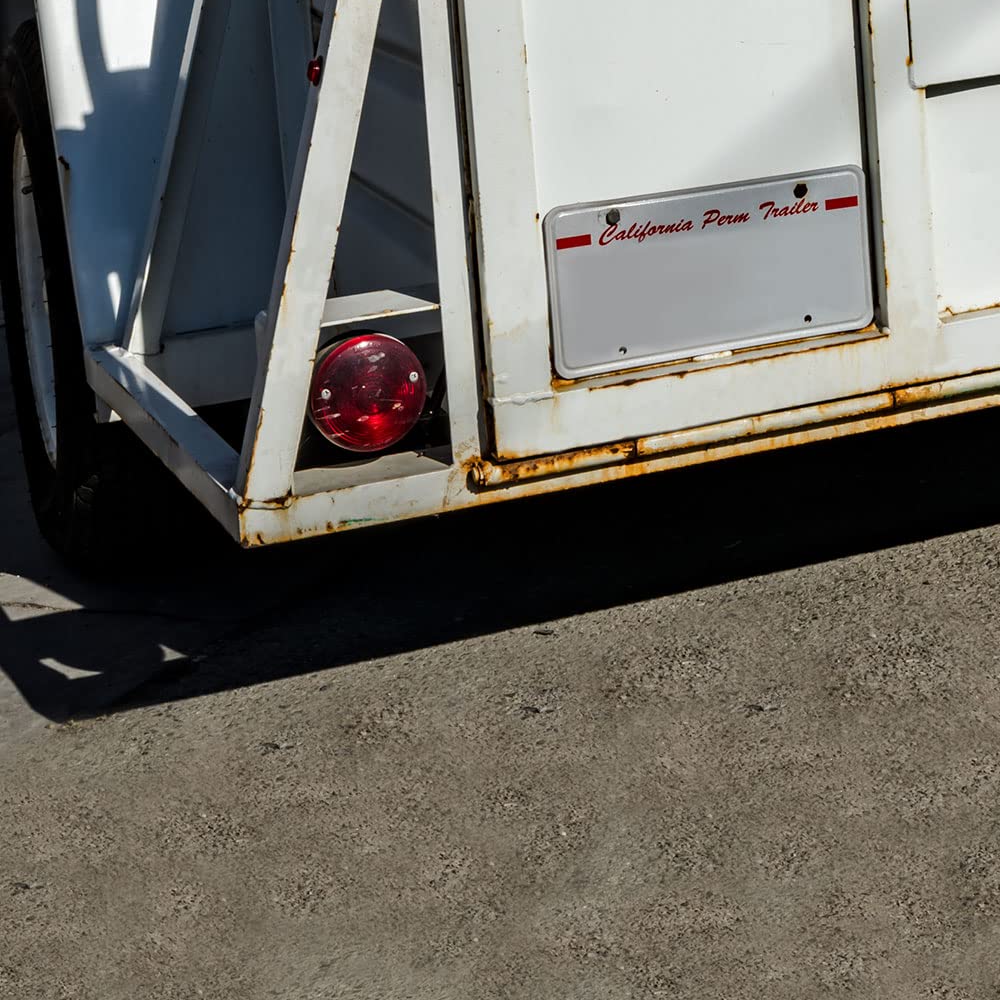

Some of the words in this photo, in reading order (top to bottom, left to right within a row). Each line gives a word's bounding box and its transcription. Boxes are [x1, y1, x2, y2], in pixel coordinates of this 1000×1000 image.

[598, 218, 694, 246] California
[701, 209, 750, 230] Perm
[759, 198, 819, 221] Trailer
